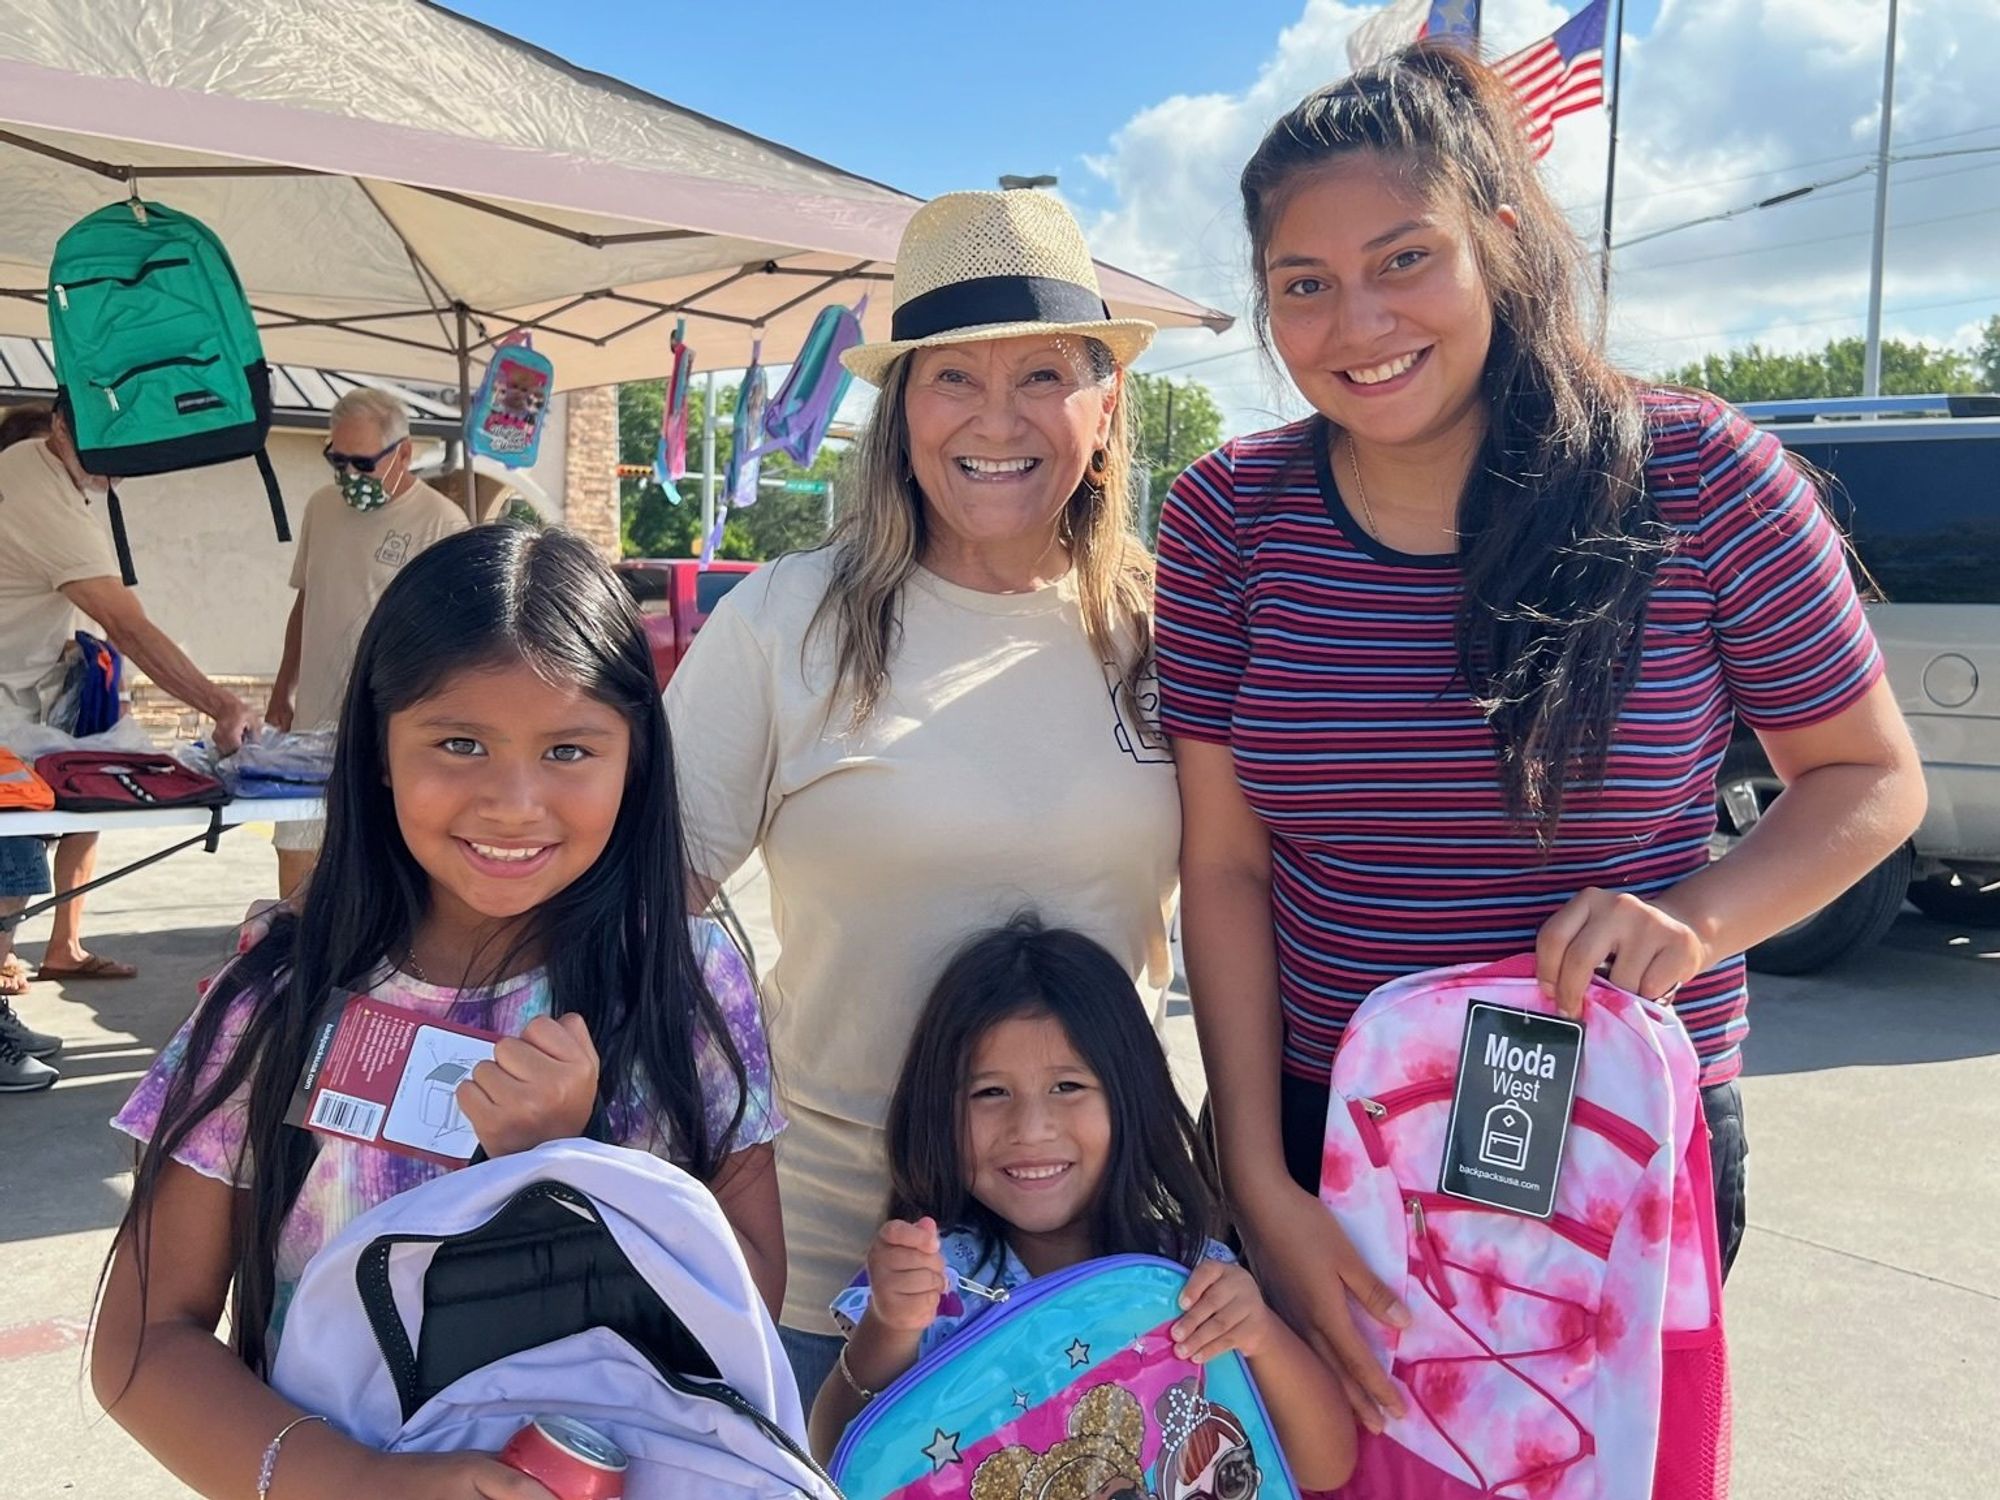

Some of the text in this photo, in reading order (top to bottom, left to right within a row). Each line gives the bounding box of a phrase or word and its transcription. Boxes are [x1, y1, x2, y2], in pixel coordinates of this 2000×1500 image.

[304, 1023, 334, 1089] backpacksusa.com
[1484, 1033, 1556, 1079] Moda
[1493, 1069, 1540, 1103] West
[1459, 1164, 1540, 1190] backpacksusa.com
